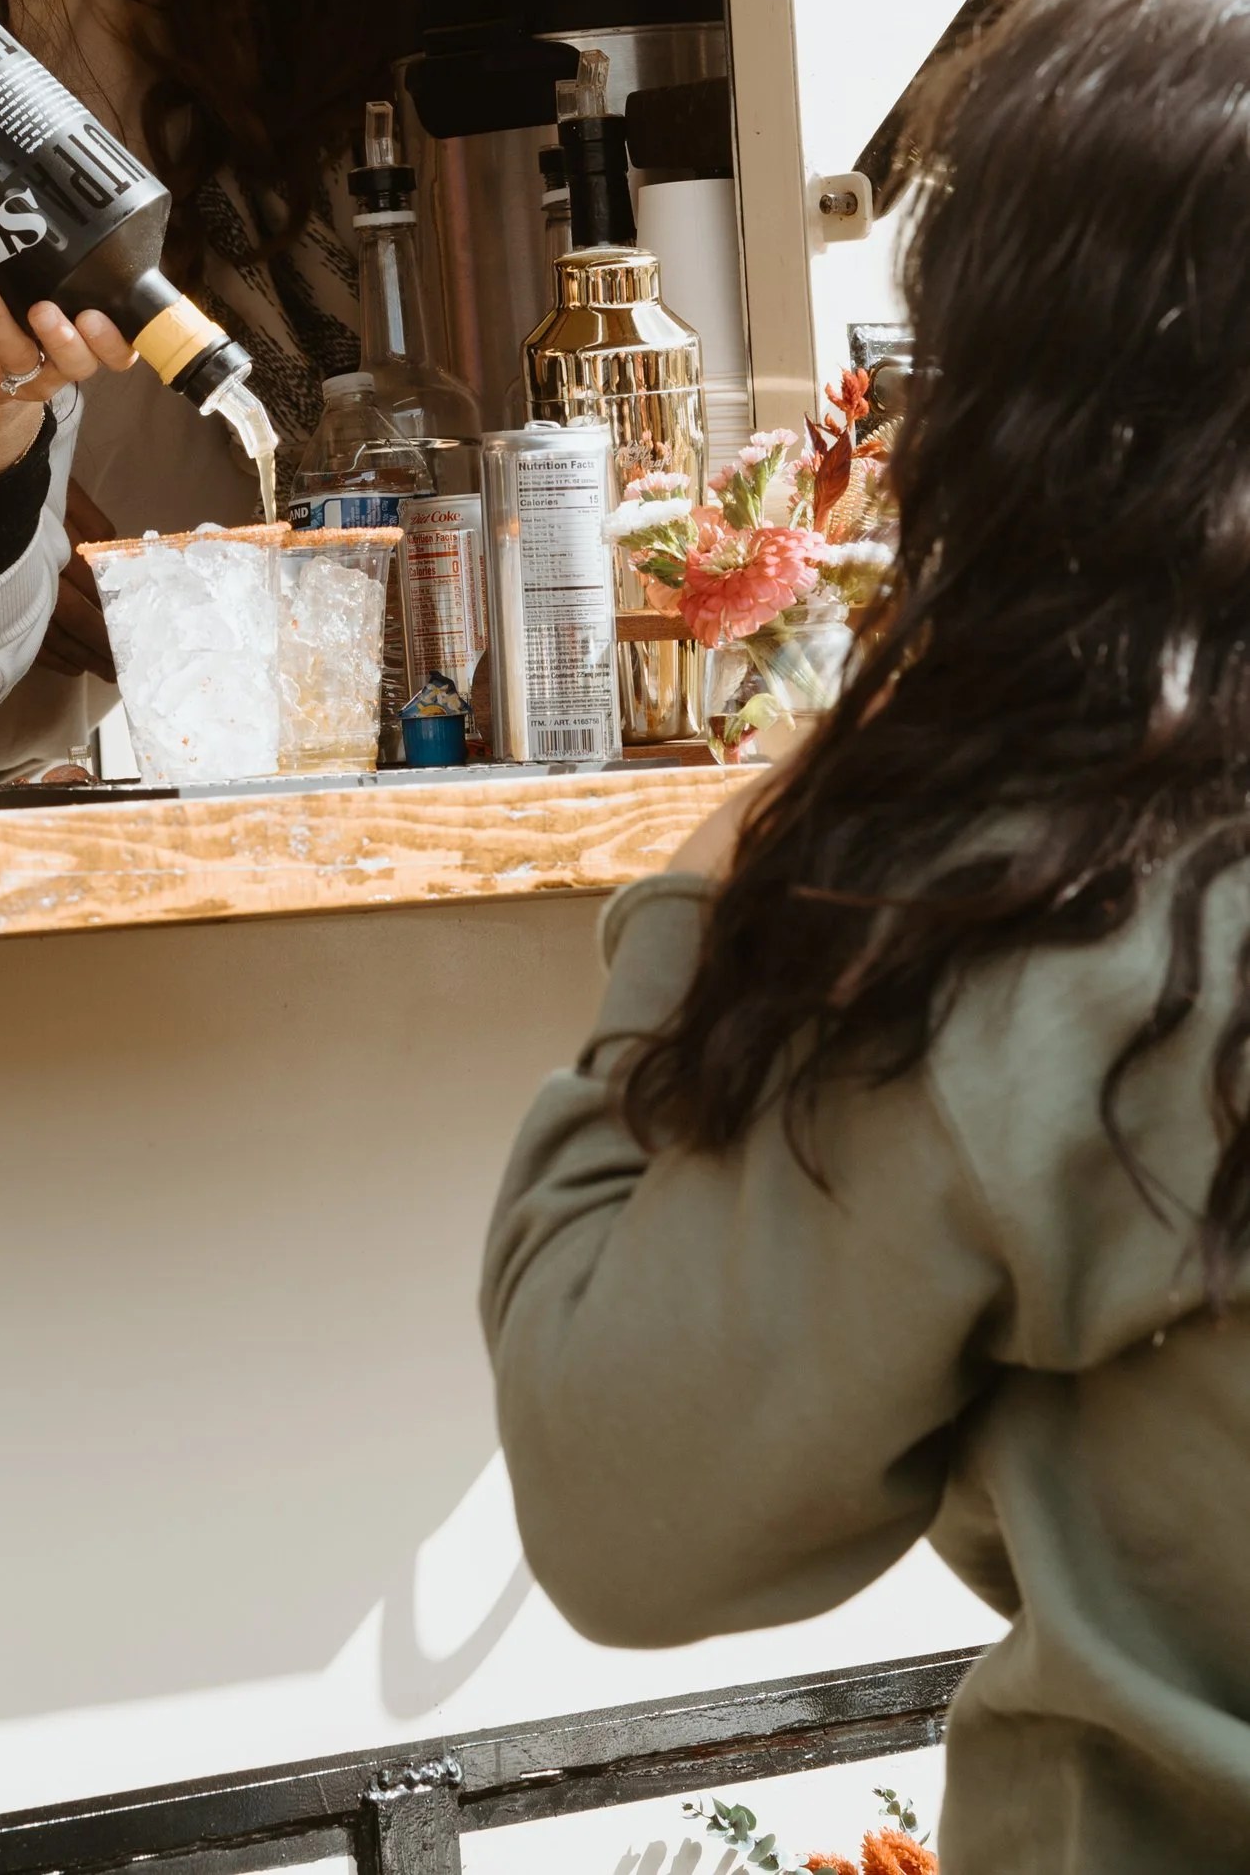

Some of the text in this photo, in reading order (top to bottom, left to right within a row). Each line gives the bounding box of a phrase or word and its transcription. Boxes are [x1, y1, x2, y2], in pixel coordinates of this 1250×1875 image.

[518, 461, 595, 471] Nutrition Facts
[590, 495, 598, 504] 15
[436, 533, 457, 541] Facts
[410, 560, 458, 577] Calories 0
